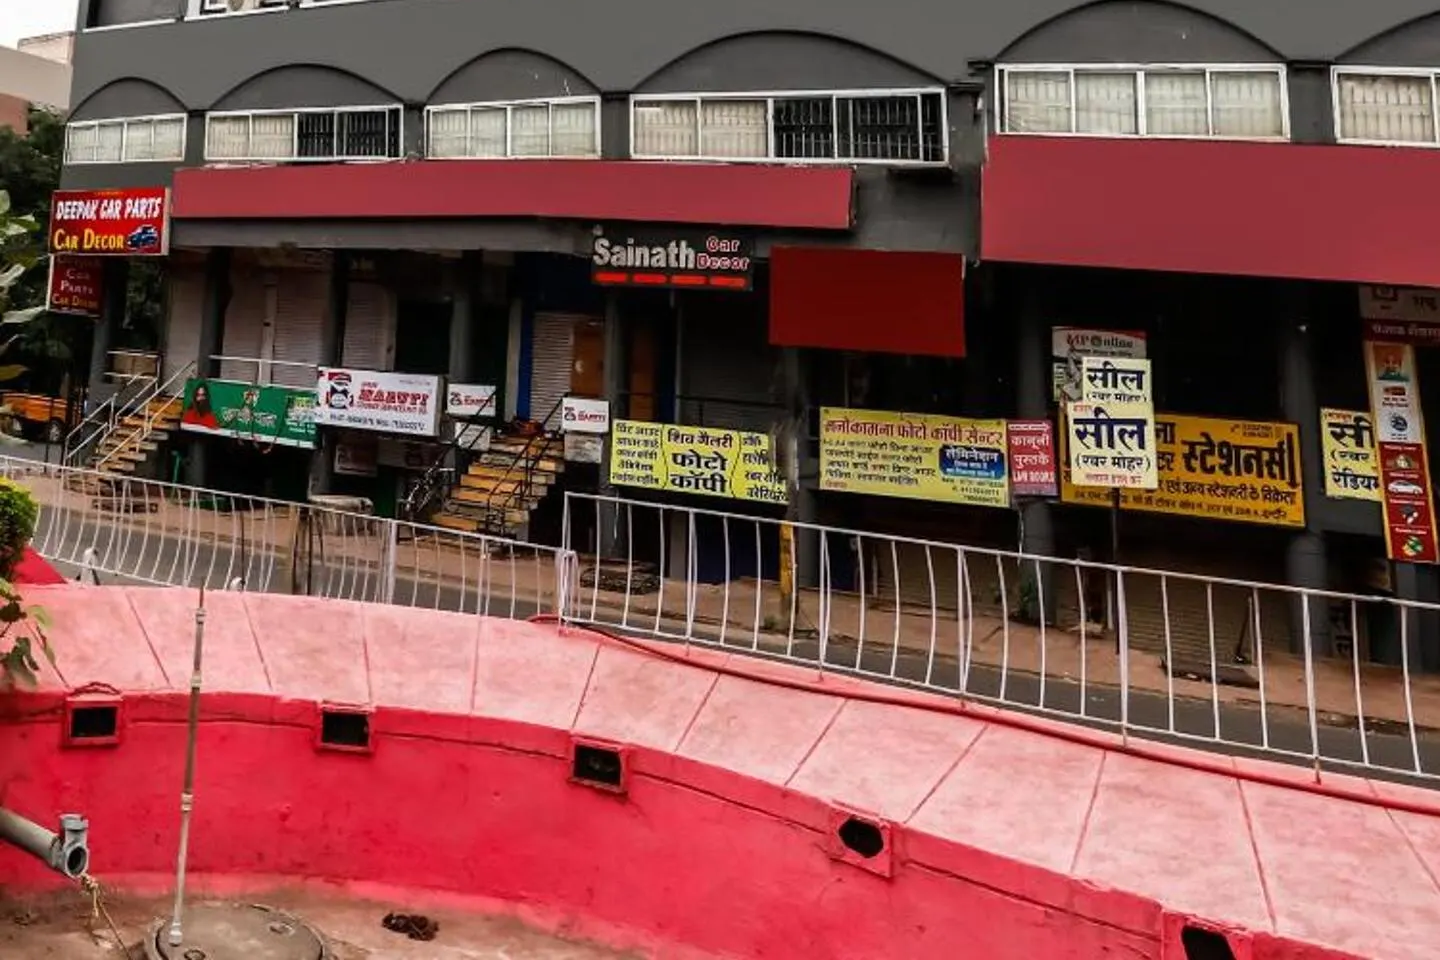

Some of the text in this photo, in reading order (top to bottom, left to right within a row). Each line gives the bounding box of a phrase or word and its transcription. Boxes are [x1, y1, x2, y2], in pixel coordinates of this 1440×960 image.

[56, 197, 161, 220] DEEPAK CAR PARTS
[54, 228, 124, 250] CAR DECOR
[593, 236, 740, 269] Sainath Car
[697, 253, 750, 271] Decor
[1087, 360, 1145, 390] सील
[668, 428, 694, 445] शिव
[898, 419, 927, 440] फोटो
[1073, 407, 1147, 451] सील
[1328, 414, 1375, 448] सी
[671, 449, 728, 471] फोटो
[670, 471, 727, 493] कॉपी
